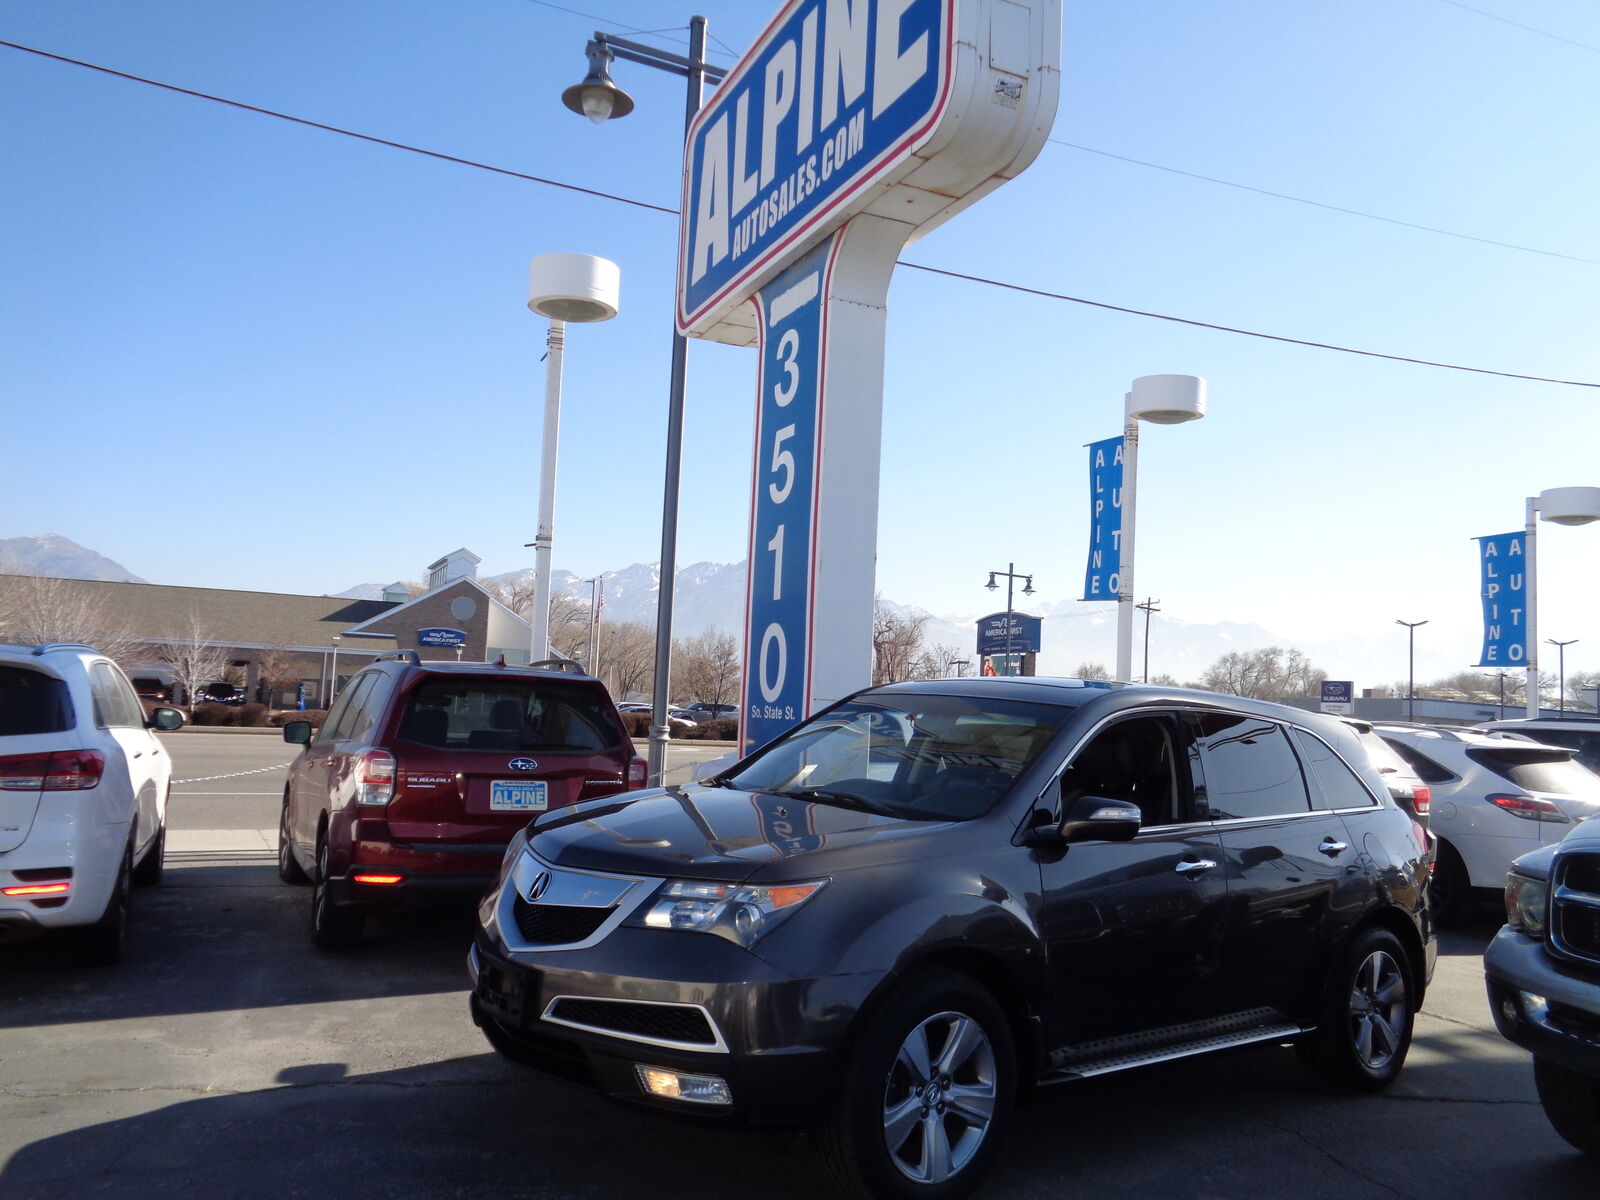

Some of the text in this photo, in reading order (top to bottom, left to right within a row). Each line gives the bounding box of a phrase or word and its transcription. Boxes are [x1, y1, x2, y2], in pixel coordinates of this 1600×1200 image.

[691, 0, 929, 286] ALPINE
[732, 108, 865, 261] AUTOSALES.COM
[1091, 449, 1105, 594] ALPINE
[1108, 445, 1124, 594] AUTO
[1485, 541, 1500, 661] ALPINE
[1508, 539, 1523, 661] AUTO
[751, 705, 796, 720] So. State St.
[494, 790, 545, 805] ALPINE
